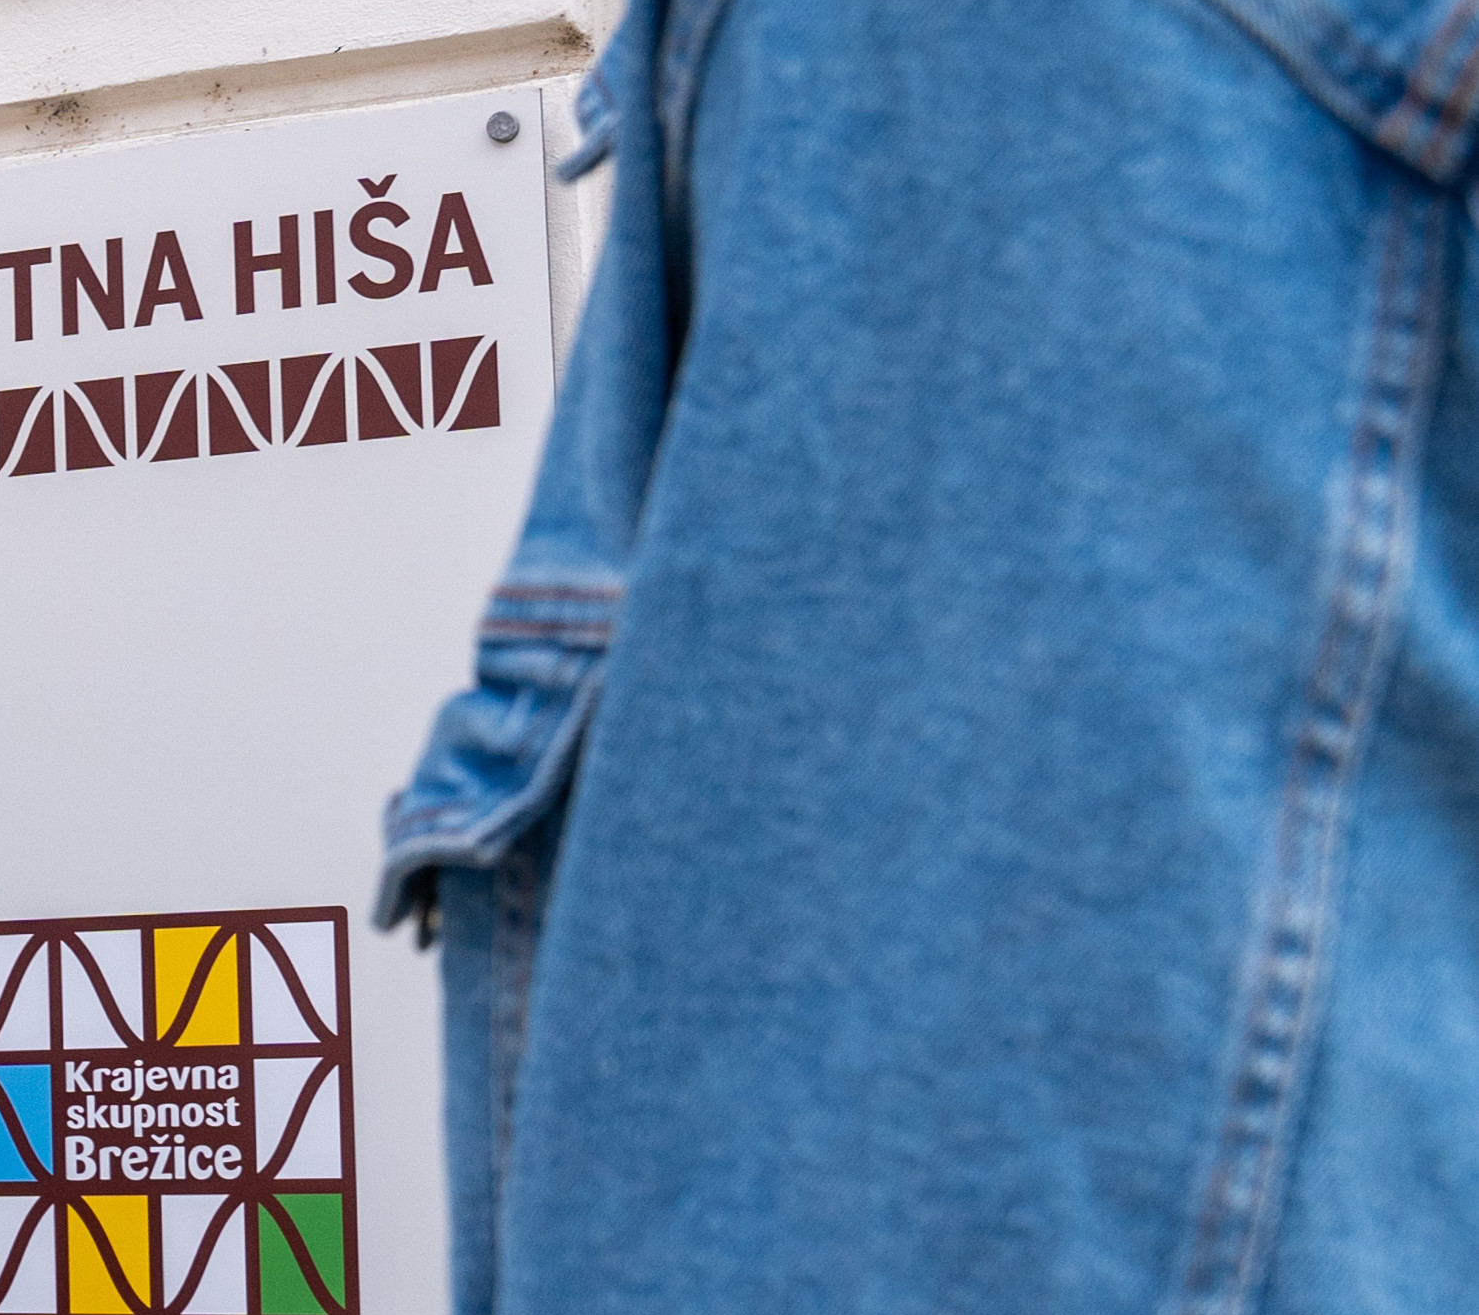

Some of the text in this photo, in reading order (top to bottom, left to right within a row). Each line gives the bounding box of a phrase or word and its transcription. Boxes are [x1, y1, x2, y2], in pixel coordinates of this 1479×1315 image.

[234, 174, 493, 315] HIŠA
[66, 1060, 238, 1101] Krajevna
[67, 1096, 241, 1137] skupnost
[65, 1134, 241, 1180] Brežice
